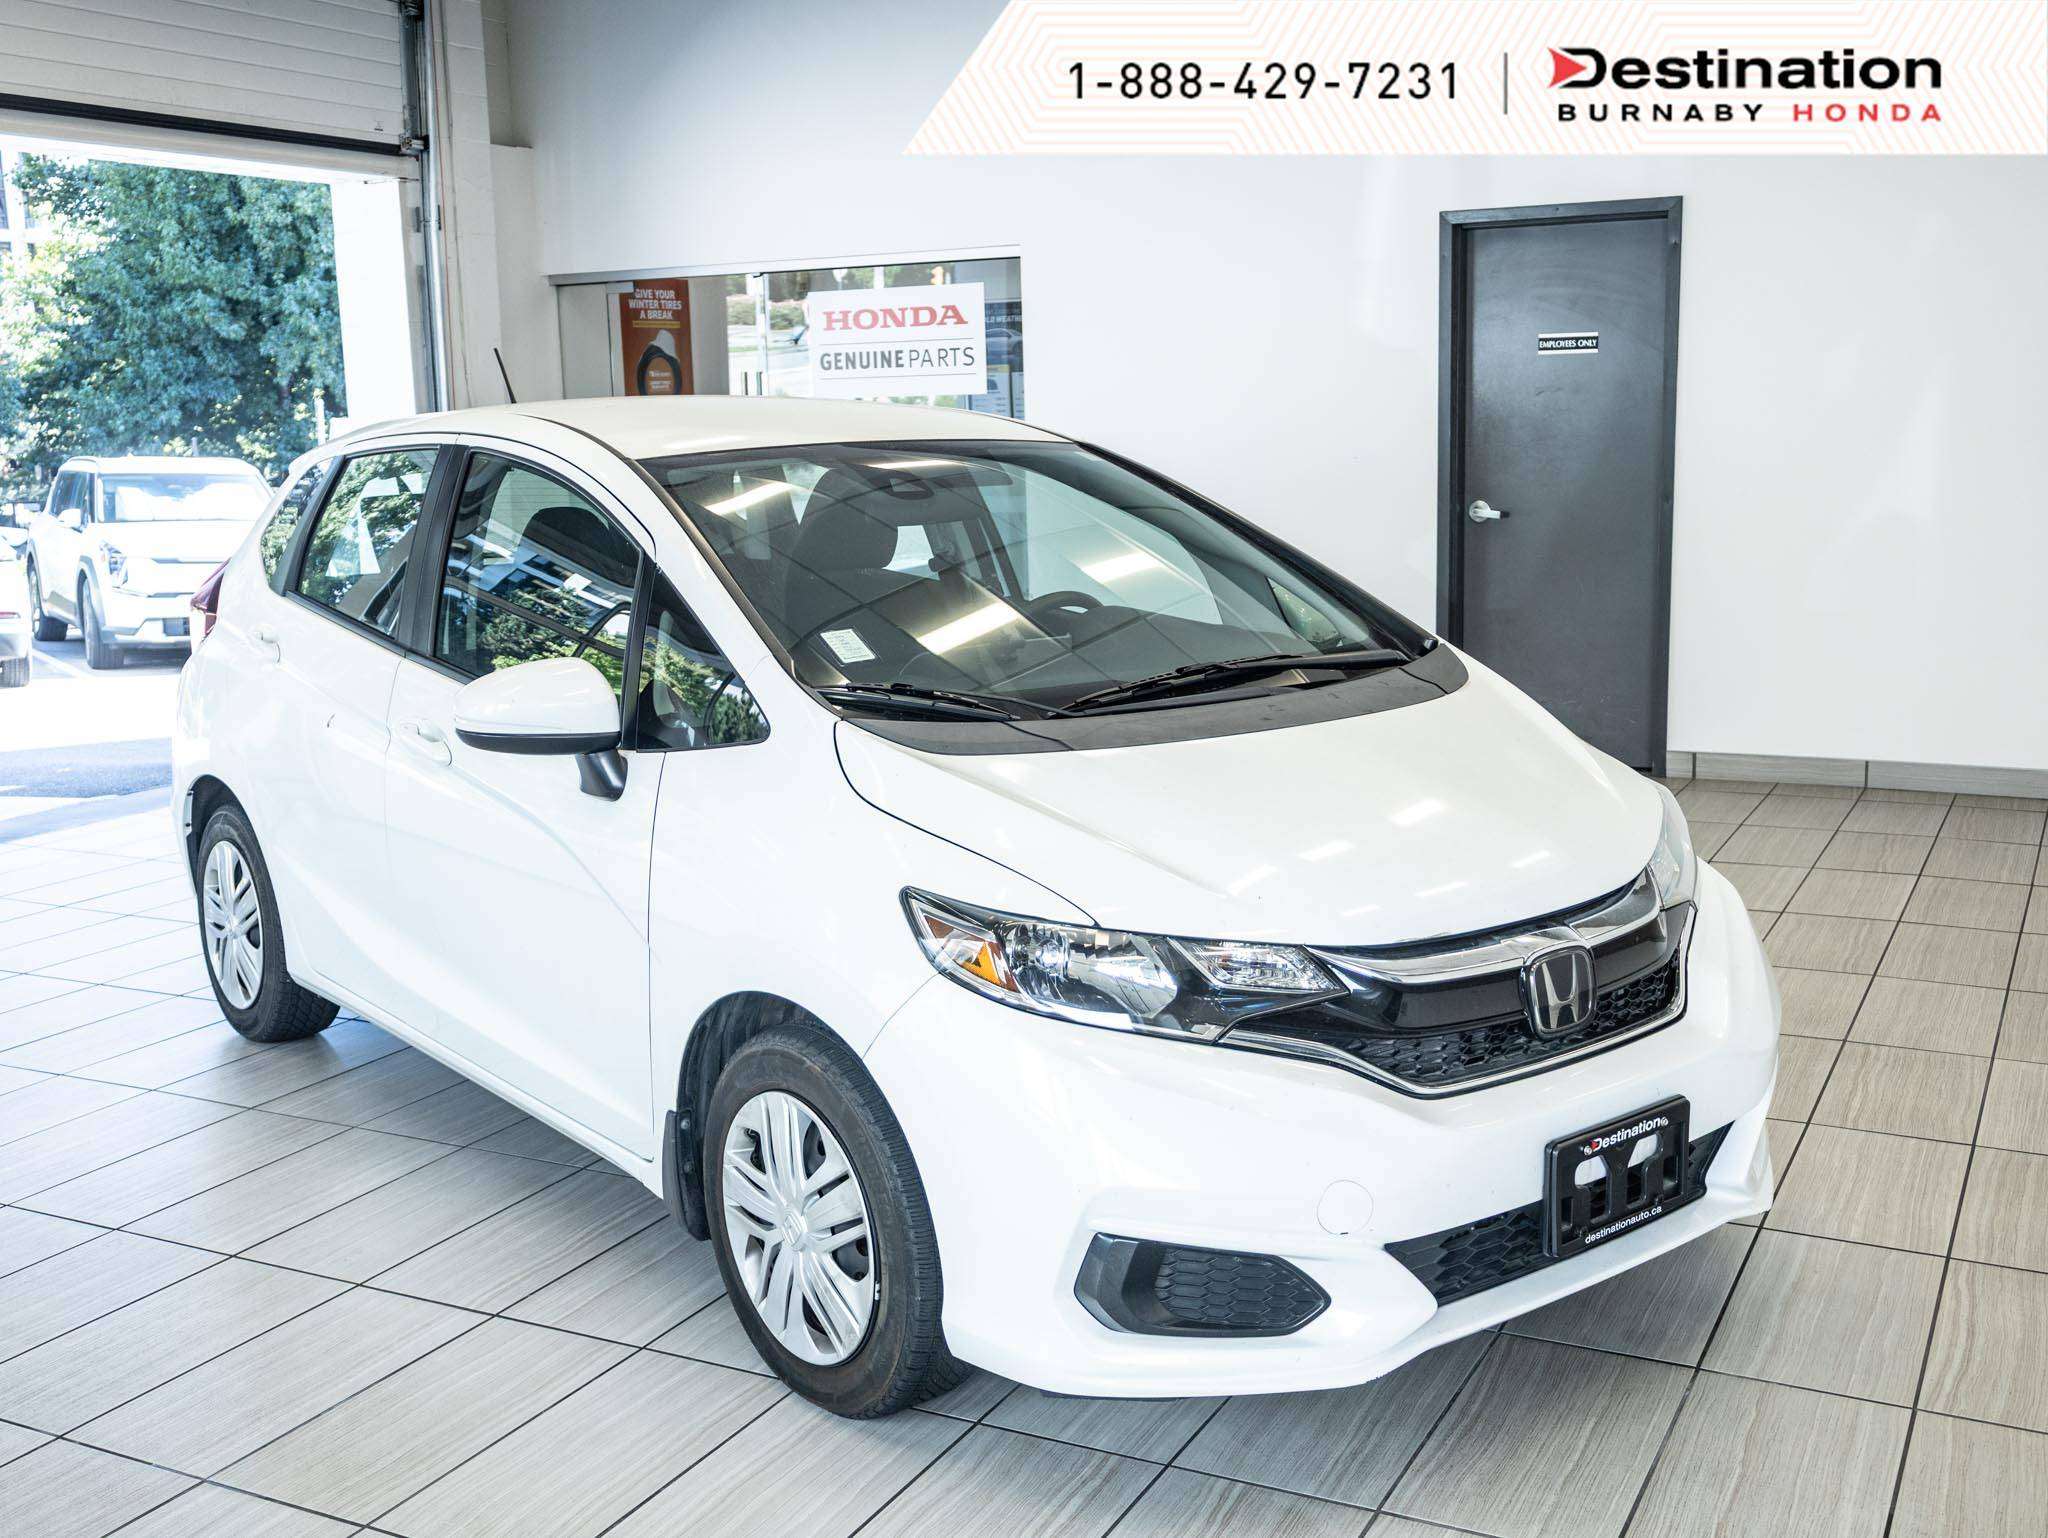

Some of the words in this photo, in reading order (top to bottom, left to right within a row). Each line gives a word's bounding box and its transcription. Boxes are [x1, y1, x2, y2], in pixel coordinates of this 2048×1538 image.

[634, 288, 654, 299] GIVE
[655, 289, 676, 300] YOUR
[628, 299, 660, 310] WINTER
[661, 300, 682, 311] TIRES
[647, 310, 674, 320] BREAK
[822, 304, 969, 332] HONDA
[1539, 340, 1576, 349] EMPLOYEES
[1577, 339, 1597, 347] ONLY
[1590, 1116, 1662, 1152] Destination
[1584, 1204, 1663, 1245] destinationauto.ca
